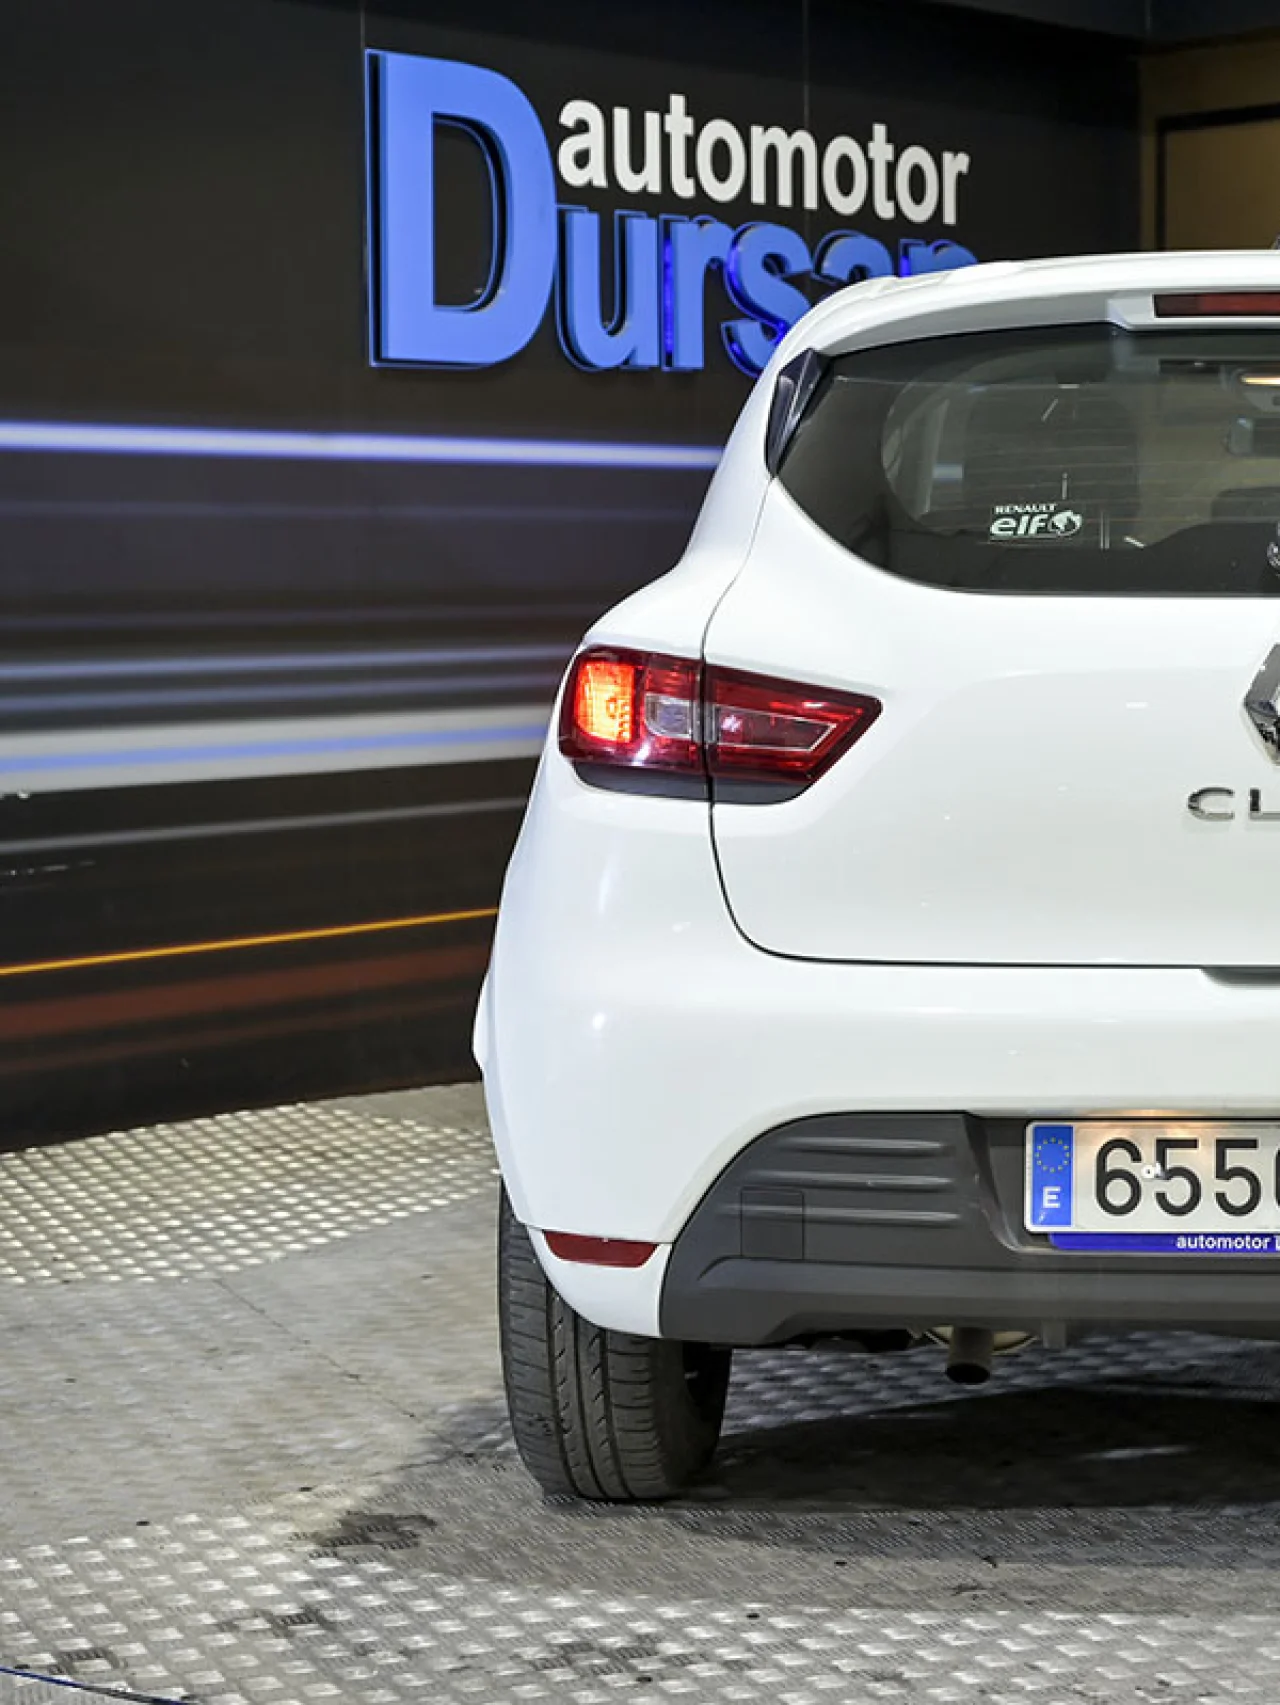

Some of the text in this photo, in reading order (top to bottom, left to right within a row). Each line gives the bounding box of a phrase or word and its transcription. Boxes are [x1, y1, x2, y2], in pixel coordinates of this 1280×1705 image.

[558, 94, 970, 225] automotor
[365, 48, 979, 379] Durs
[1042, 1186, 1061, 1208] E
[1176, 1234, 1271, 1250] automotor
